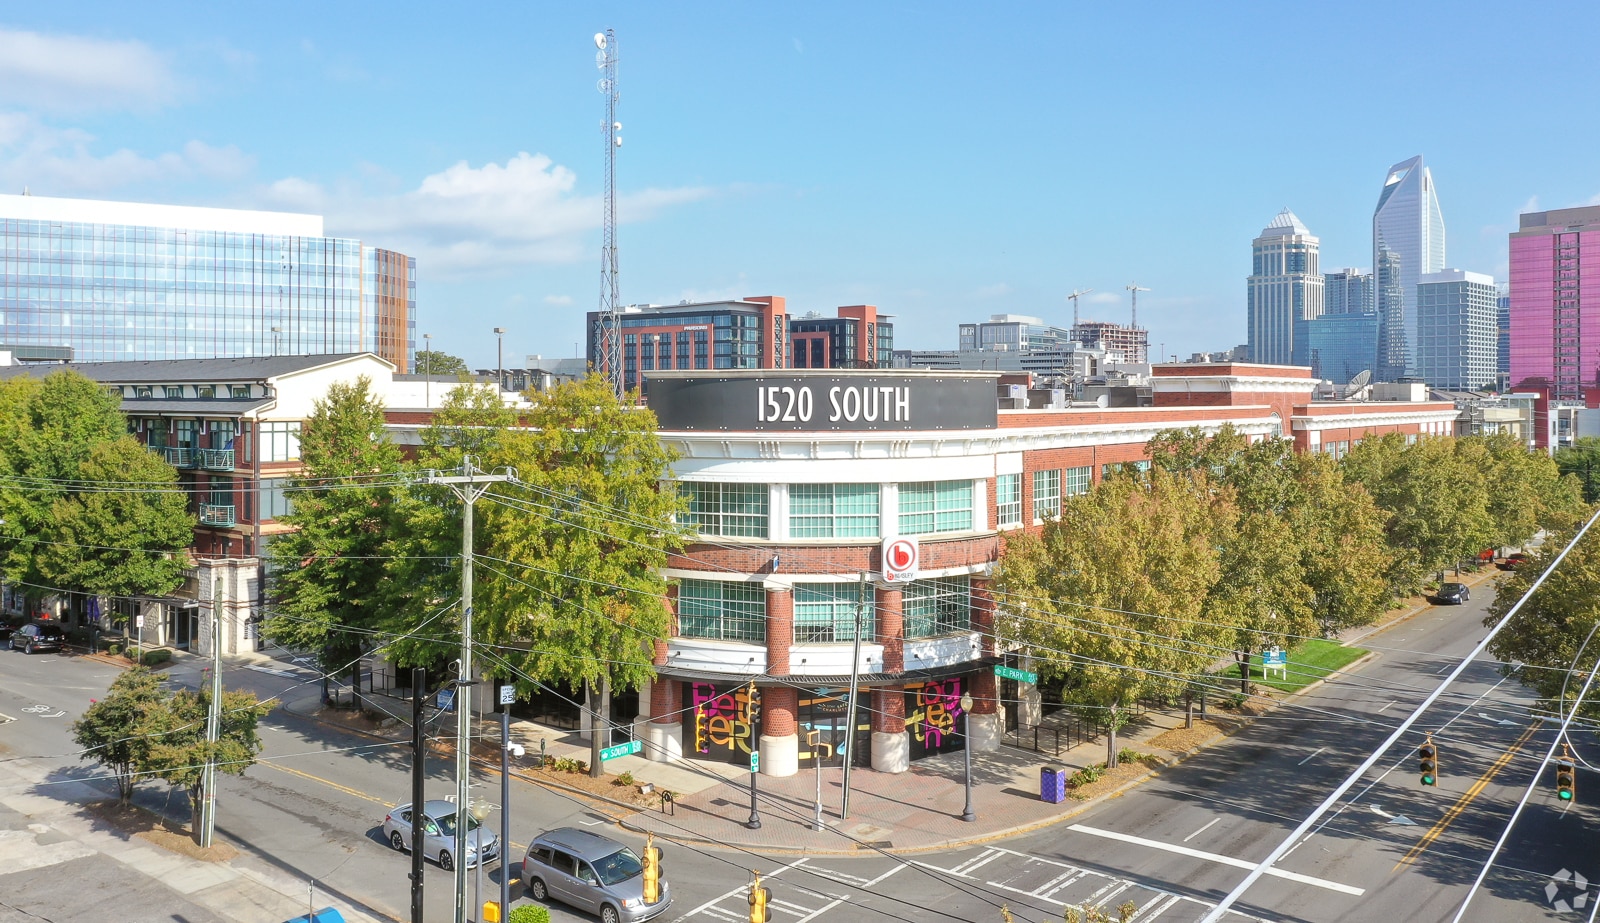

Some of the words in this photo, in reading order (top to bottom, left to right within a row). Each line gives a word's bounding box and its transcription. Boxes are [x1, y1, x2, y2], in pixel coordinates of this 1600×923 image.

[757, 386, 813, 422] 1520
[828, 386, 910, 422] SOUTH
[1009, 669, 1024, 680] PARK
[502, 694, 514, 703] 25
[610, 745, 630, 758] SOUTH
